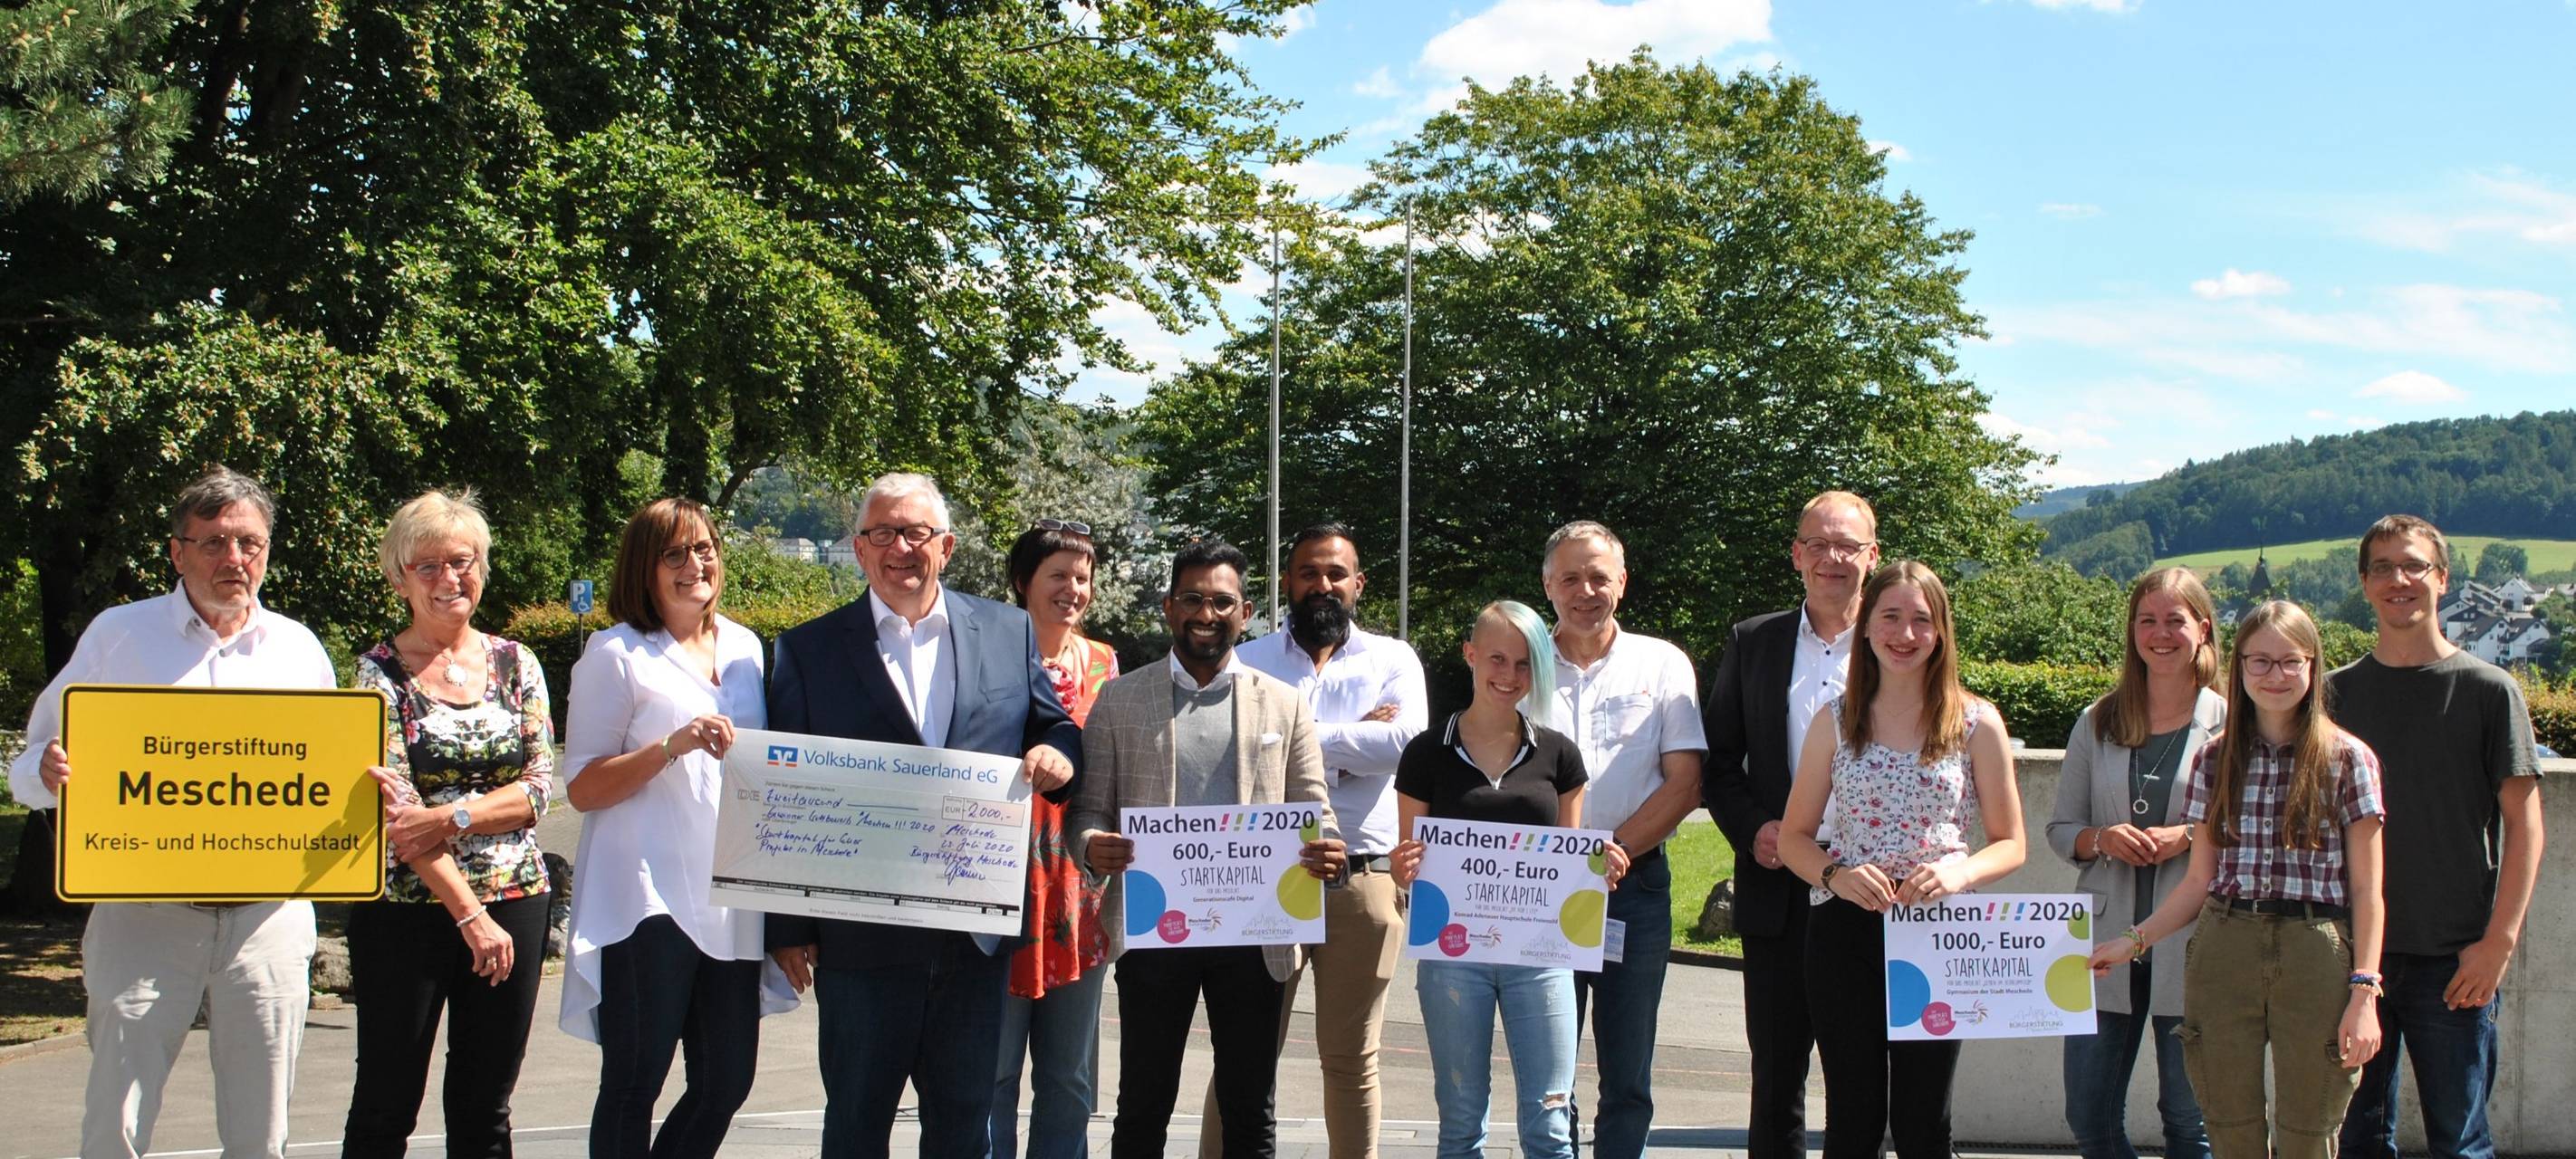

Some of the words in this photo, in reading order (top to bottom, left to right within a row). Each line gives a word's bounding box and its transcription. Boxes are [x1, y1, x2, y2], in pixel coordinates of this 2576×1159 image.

[572, 582, 586, 602] P
[142, 735, 308, 761] Bürgerstiftung
[803, 749, 887, 771] Volksbank
[892, 758, 972, 781] Sauerland
[976, 769, 998, 783] eG
[119, 770, 332, 807] Meschede
[909, 820, 936, 833] 2020
[1263, 810, 1315, 830] 2020
[85, 832, 149, 851] Kreis-
[157, 832, 195, 851] und
[202, 833, 360, 851] Hochschulstadt
[985, 842, 1014, 853] 2020
[1173, 842, 1223, 861] 600,-
[1228, 841, 1273, 858] Euro
[1552, 835, 1606, 857] 2020
[1180, 865, 1266, 886] STARTKAPITAL
[1460, 857, 1510, 879] 400,-
[1515, 860, 1559, 882] Euro
[1465, 882, 1549, 907] STARTKAPITAL
[2029, 902, 2085, 921] 2020
[1932, 932, 1994, 952] 1000,-
[1999, 931, 2046, 949] Euro
[1945, 956, 2033, 978] STARTKAPITAL
